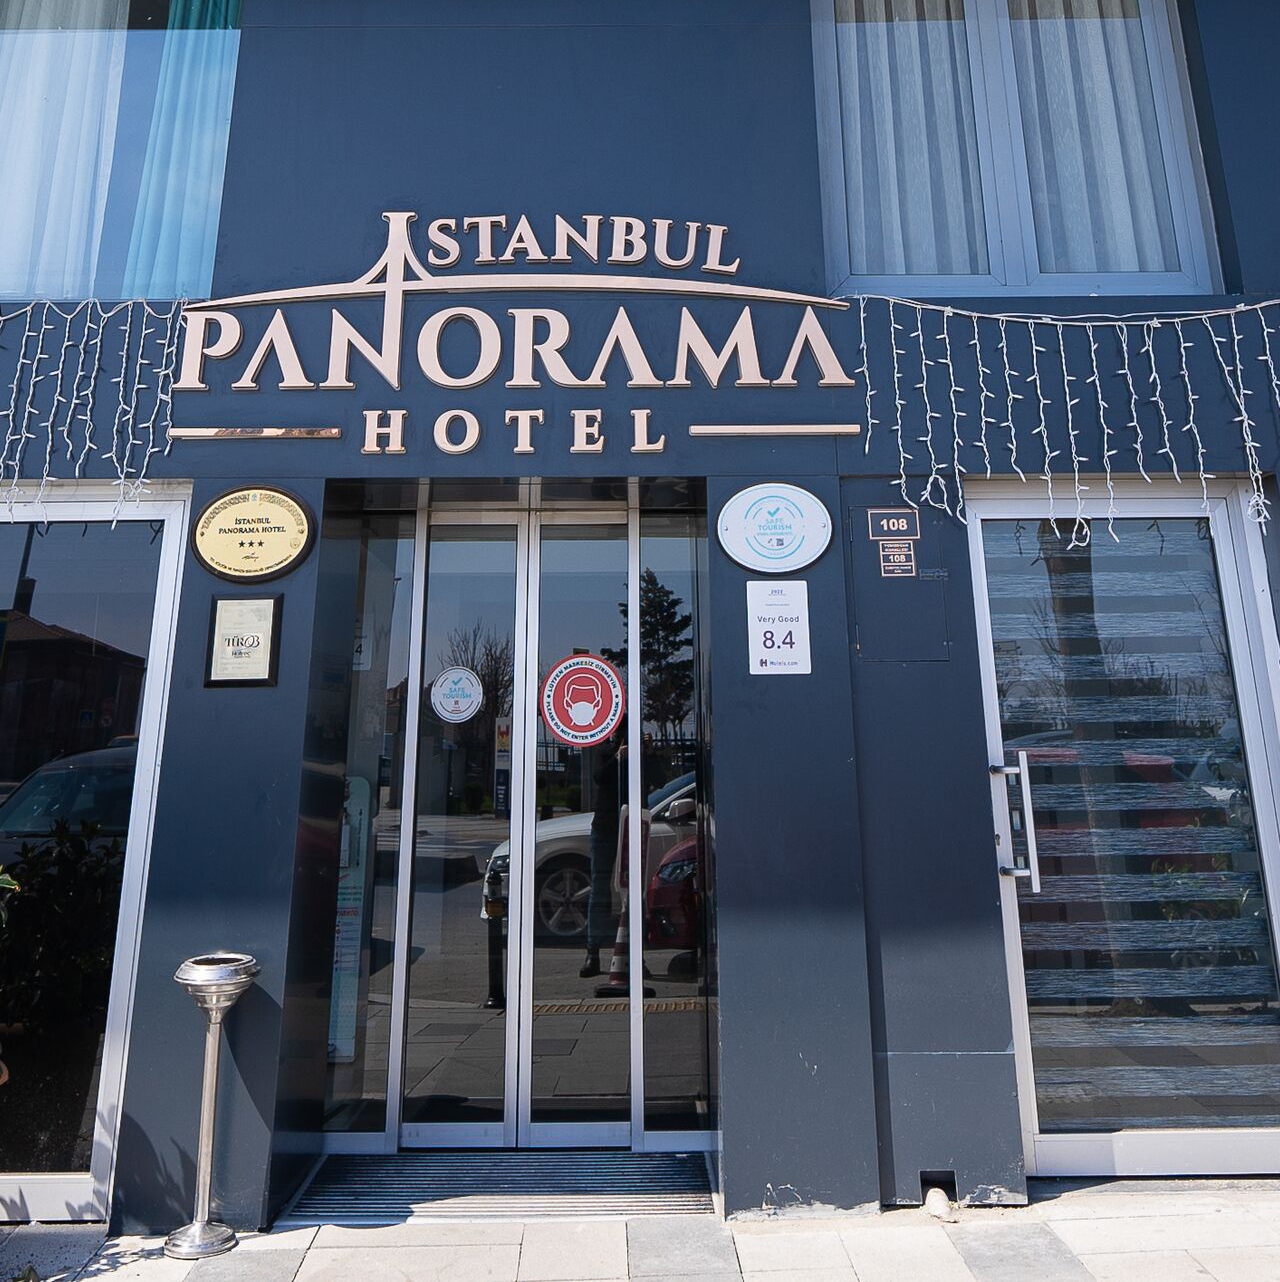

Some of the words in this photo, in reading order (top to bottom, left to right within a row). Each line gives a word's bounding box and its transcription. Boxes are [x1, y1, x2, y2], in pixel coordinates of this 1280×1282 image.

[172, 306, 857, 390] PANORAMA
[360, 409, 666, 455] HOTEL
[880, 518, 908, 531] 108
[888, 554, 906, 563] 108
[757, 616, 776, 624] Very
[777, 615, 800, 623] Good
[762, 629, 796, 650] 8.4
[548, 669, 564, 692] LÜTFEN
[546, 701, 556, 722] PLEASE
[560, 727, 571, 737] NOT
[589, 722, 611, 739] WITHOUT
[612, 701, 620, 718] MASK
